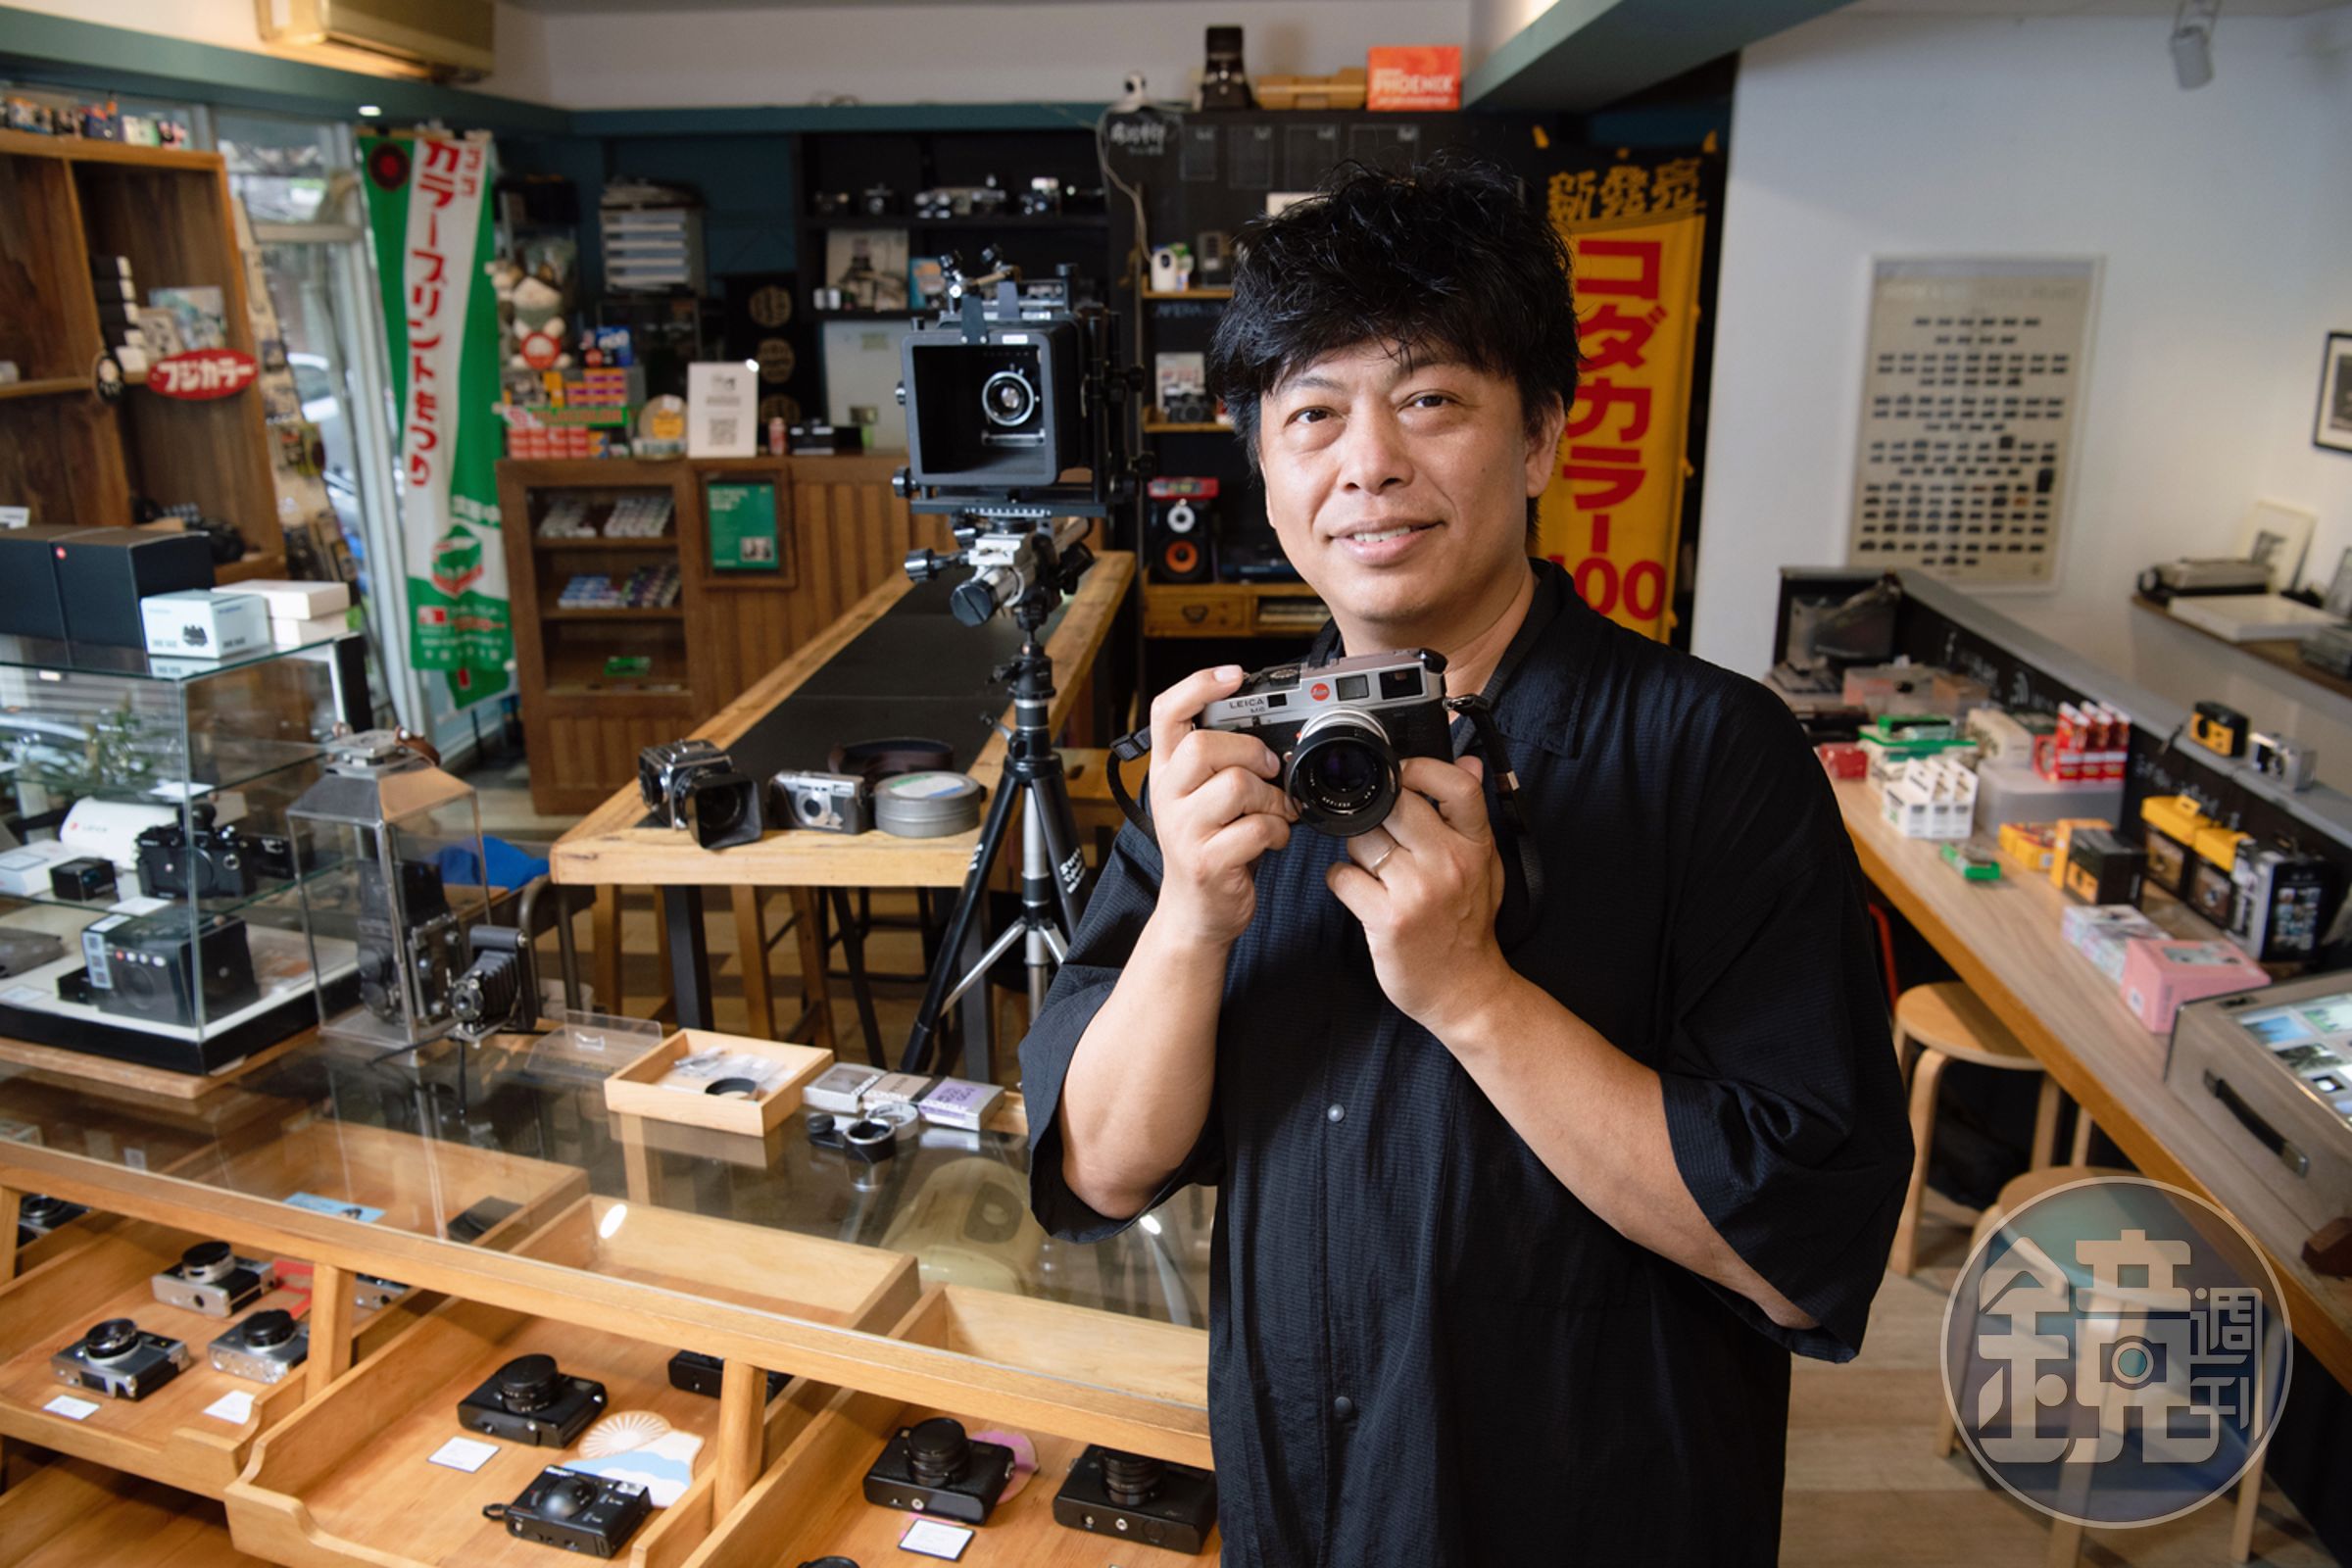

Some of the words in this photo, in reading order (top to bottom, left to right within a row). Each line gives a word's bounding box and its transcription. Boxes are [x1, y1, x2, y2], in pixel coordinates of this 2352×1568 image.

[158, 358, 254, 391] フジカラー
[1563, 239, 1669, 554] コダカラー
[1547, 555, 1666, 621] 00
[1229, 697, 1264, 710] LEICA
